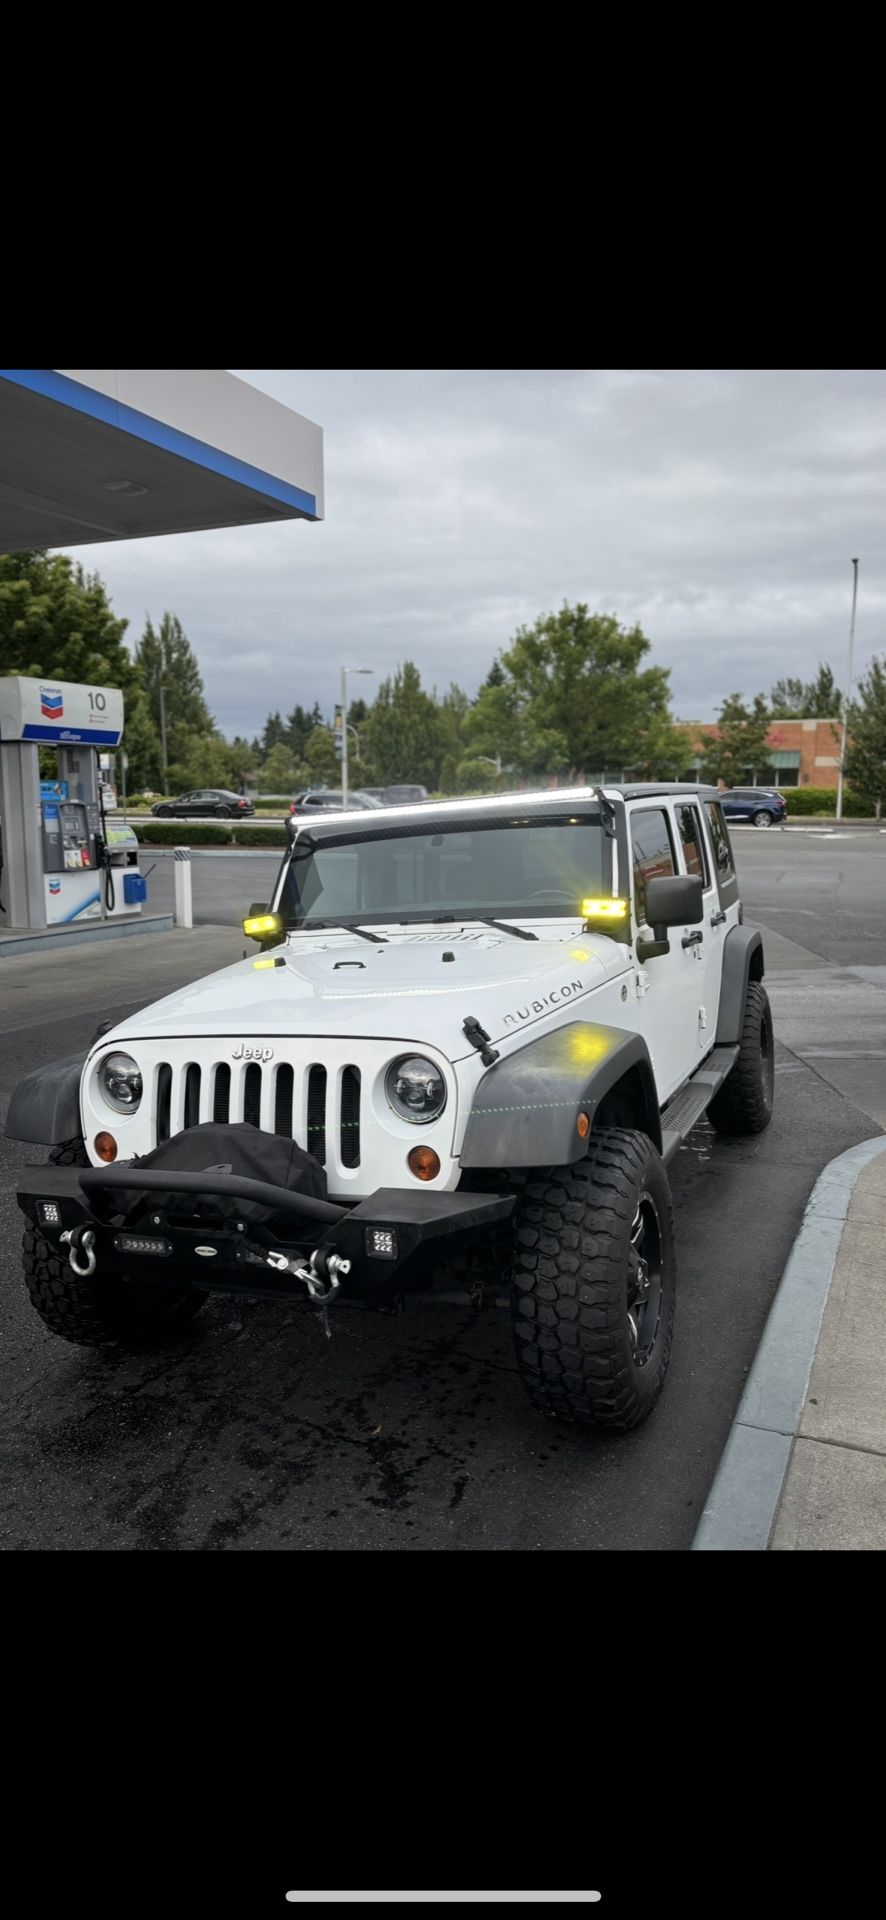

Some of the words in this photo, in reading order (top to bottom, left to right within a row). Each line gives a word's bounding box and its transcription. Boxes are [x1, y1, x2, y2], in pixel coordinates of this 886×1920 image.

[87, 692, 106, 711] 10
[503, 979, 583, 1027] RUBICON
[231, 1043, 275, 1064] Jeep
